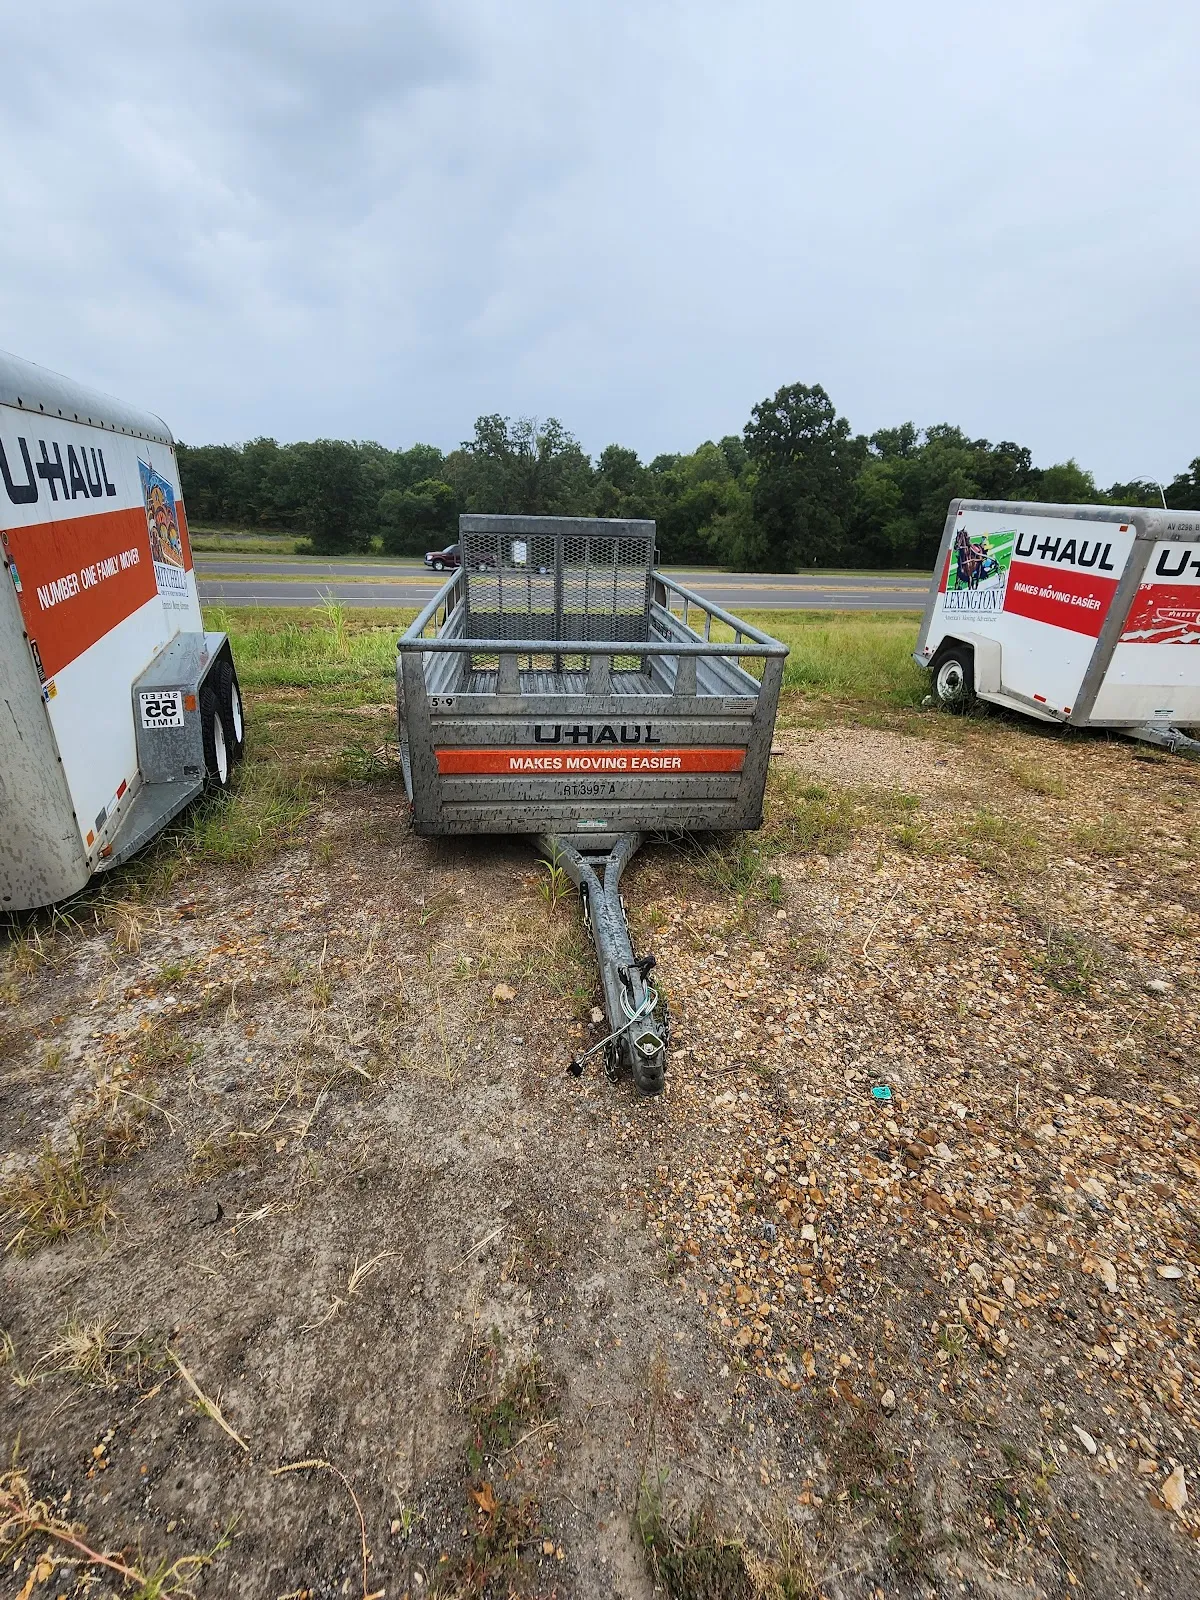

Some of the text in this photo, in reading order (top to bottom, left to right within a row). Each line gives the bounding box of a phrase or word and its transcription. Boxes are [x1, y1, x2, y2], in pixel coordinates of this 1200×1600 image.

[1167, 523, 1176, 531] AV
[36, 572, 81, 611] NUMBER
[80, 564, 98, 590] ONE
[96, 555, 120, 582] FAMILY
[119, 547, 140, 571] MOVER
[943, 590, 1000, 610] LEXINGTON
[1013, 582, 1102, 611] MAKES MOVING EASIER
[1168, 610, 1197, 618] FINEST
[509, 757, 682, 770] MAKES MOVING EASIER
